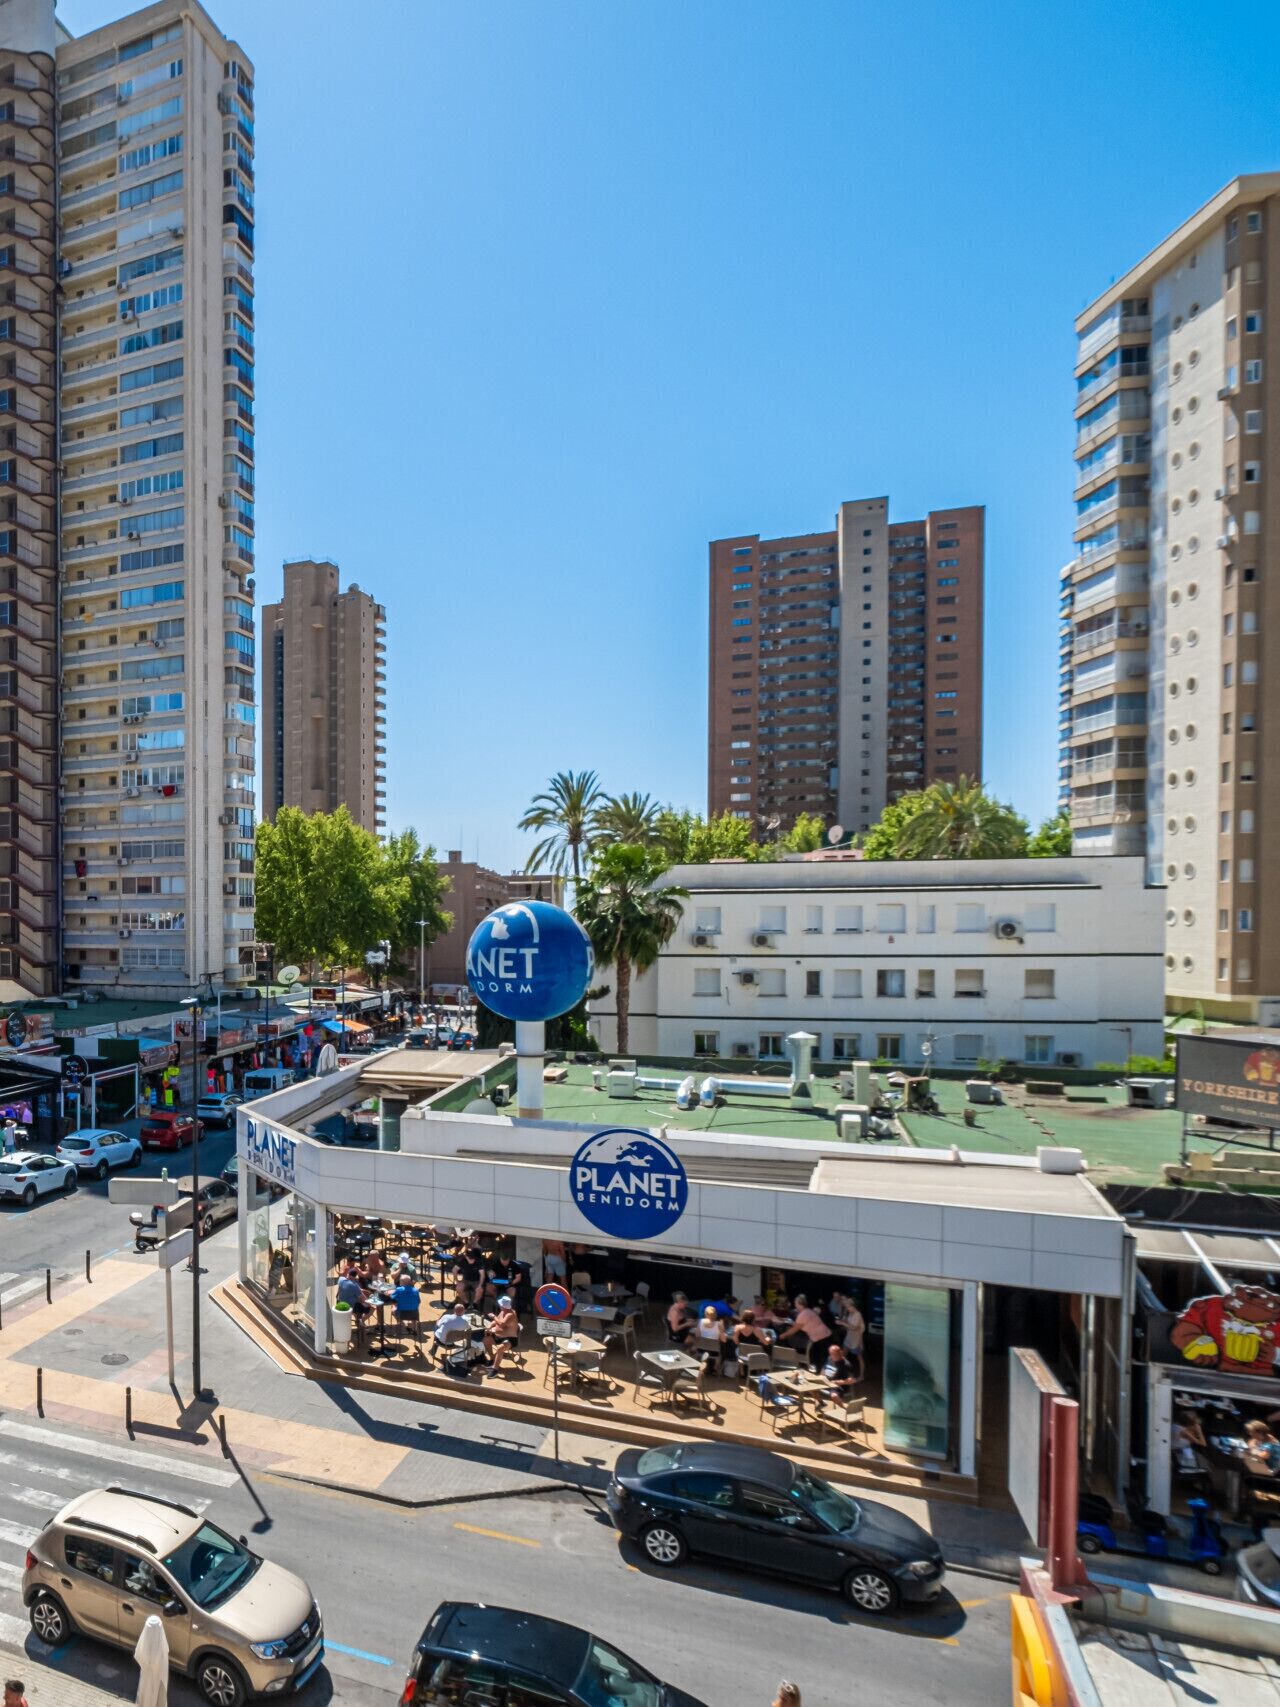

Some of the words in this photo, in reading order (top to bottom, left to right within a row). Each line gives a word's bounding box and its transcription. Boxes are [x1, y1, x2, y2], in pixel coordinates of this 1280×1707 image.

[1182, 1078, 1279, 1105] YORKSHIRE
[247, 1119, 297, 1171] PLANET
[576, 1166, 682, 1198] PLANET
[577, 1192, 680, 1212] BENIDORM
